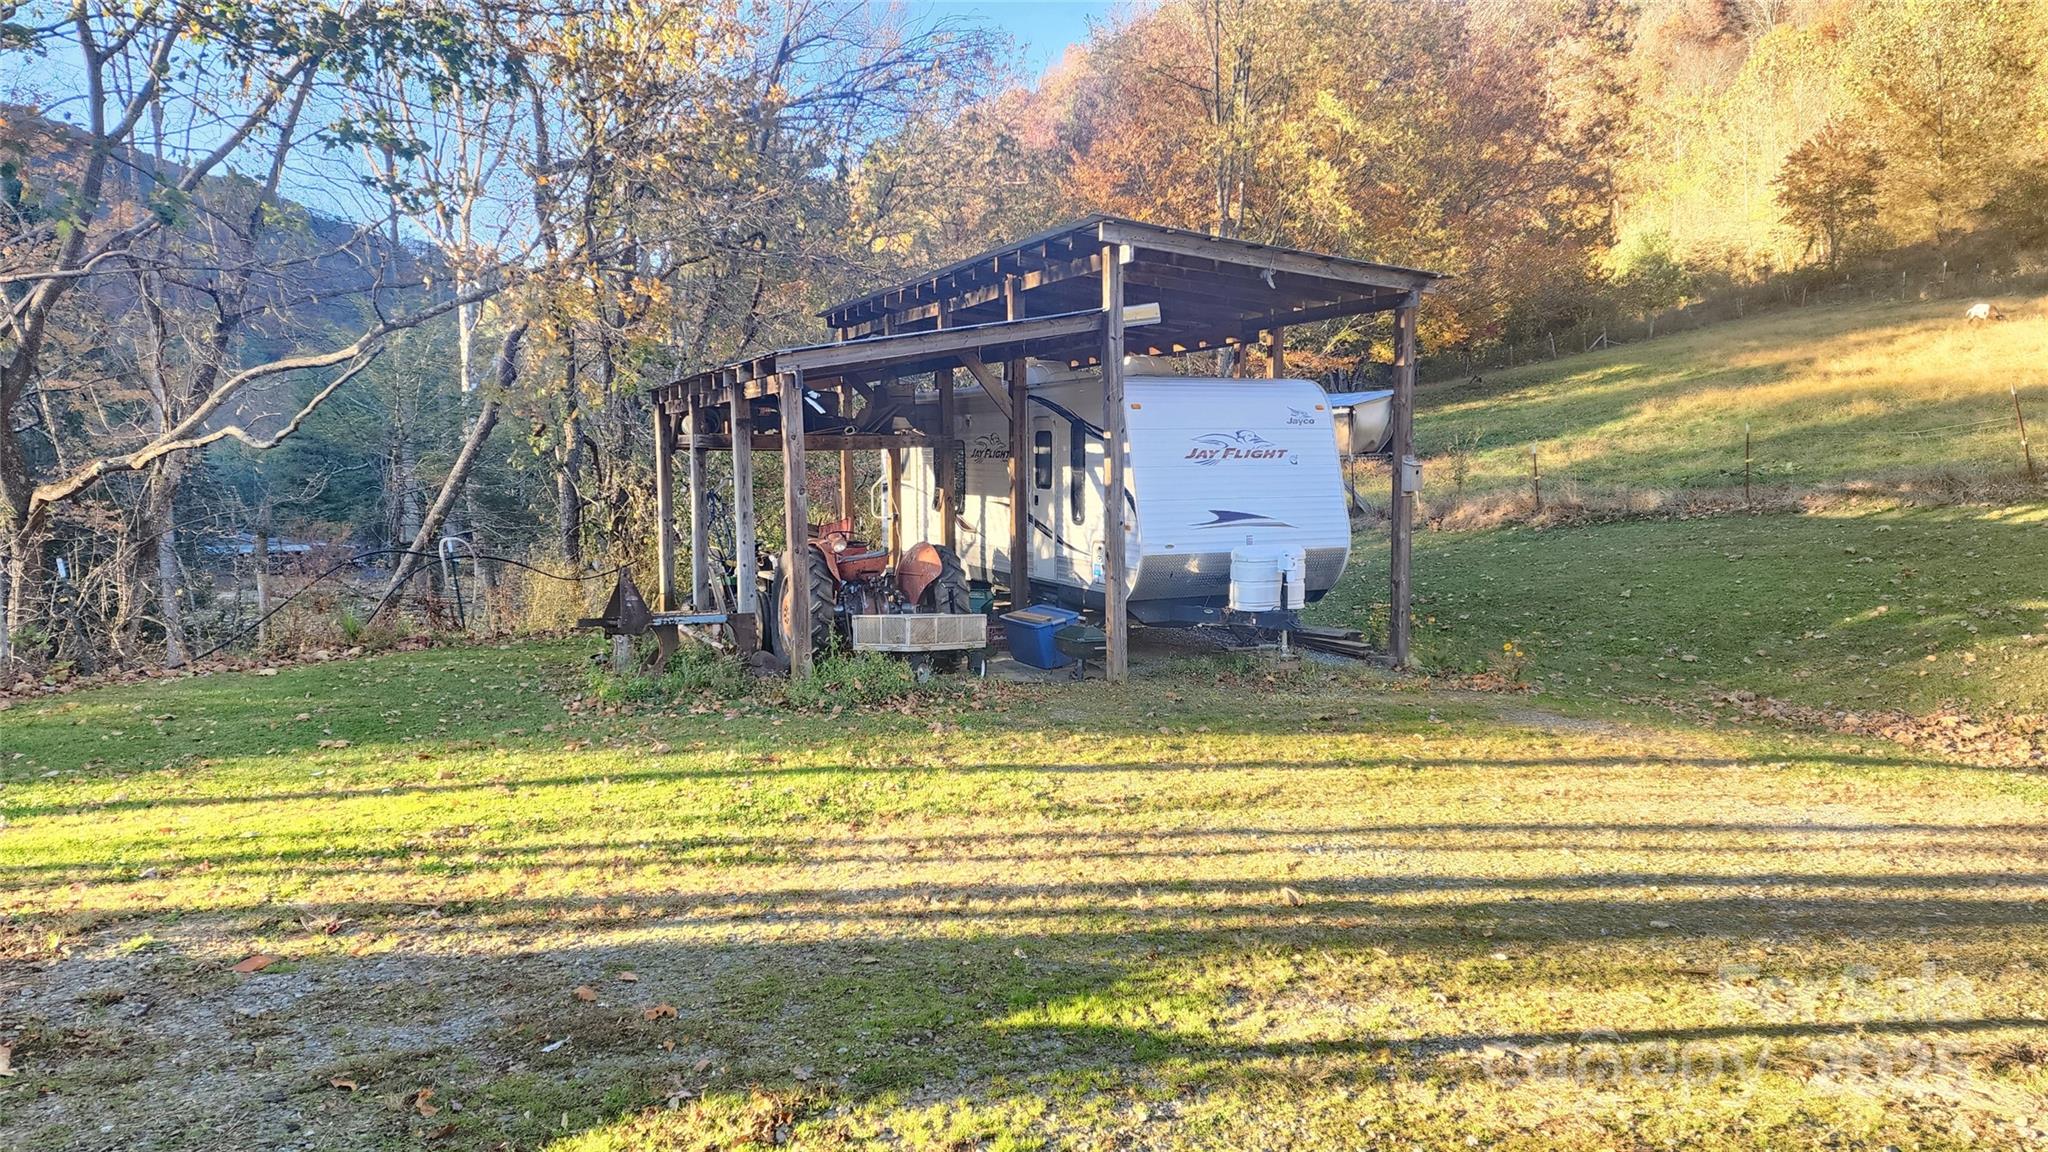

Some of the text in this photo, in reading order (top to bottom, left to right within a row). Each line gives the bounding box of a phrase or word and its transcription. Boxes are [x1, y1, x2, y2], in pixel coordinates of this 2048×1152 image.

[1286, 417, 1315, 426] Jayco
[971, 449, 985, 458] JAY
[1184, 448, 1219, 459] JAY
[1221, 447, 1288, 460] FLIGHT
